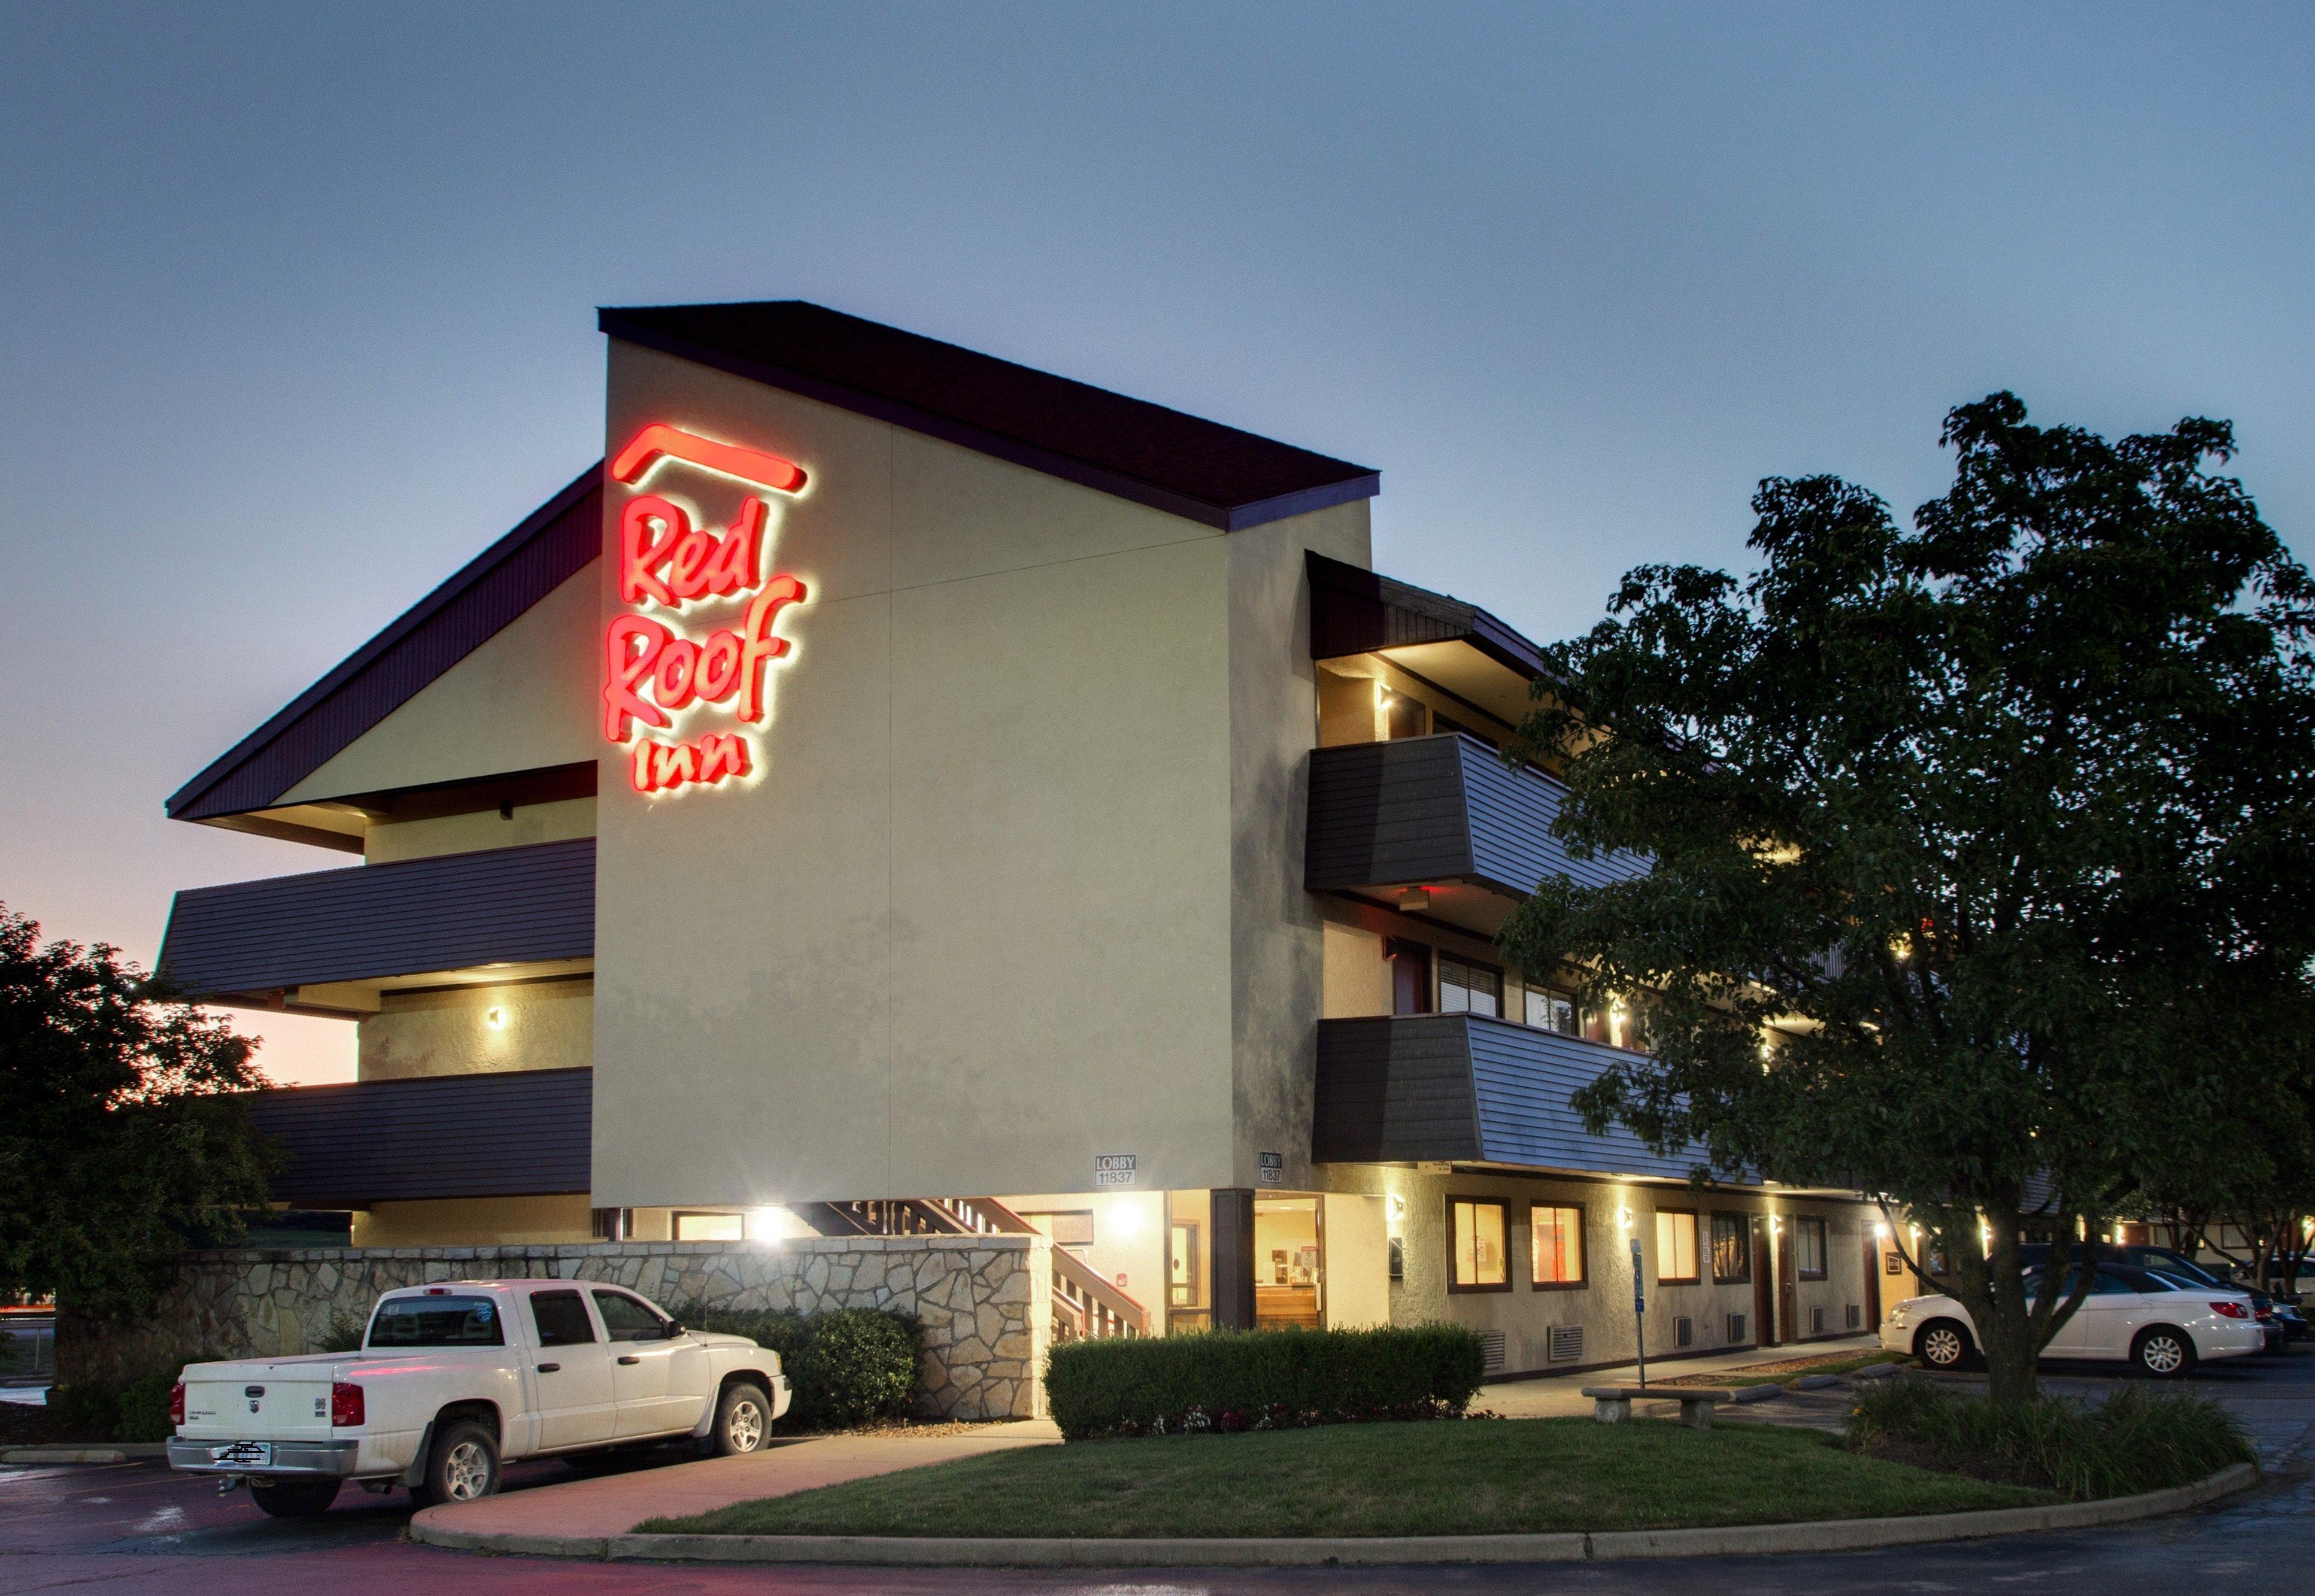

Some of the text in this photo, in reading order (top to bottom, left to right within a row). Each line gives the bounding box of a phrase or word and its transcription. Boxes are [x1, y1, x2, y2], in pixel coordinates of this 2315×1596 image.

[623, 496, 769, 608] Red
[604, 576, 808, 742] Roof
[634, 733, 753, 792] Inn
[1096, 1157, 1134, 1170] LOBBY
[1261, 1154, 1281, 1167] LOBBY
[1099, 1172, 1132, 1184] 11837
[1263, 1169, 1280, 1181] 11837
